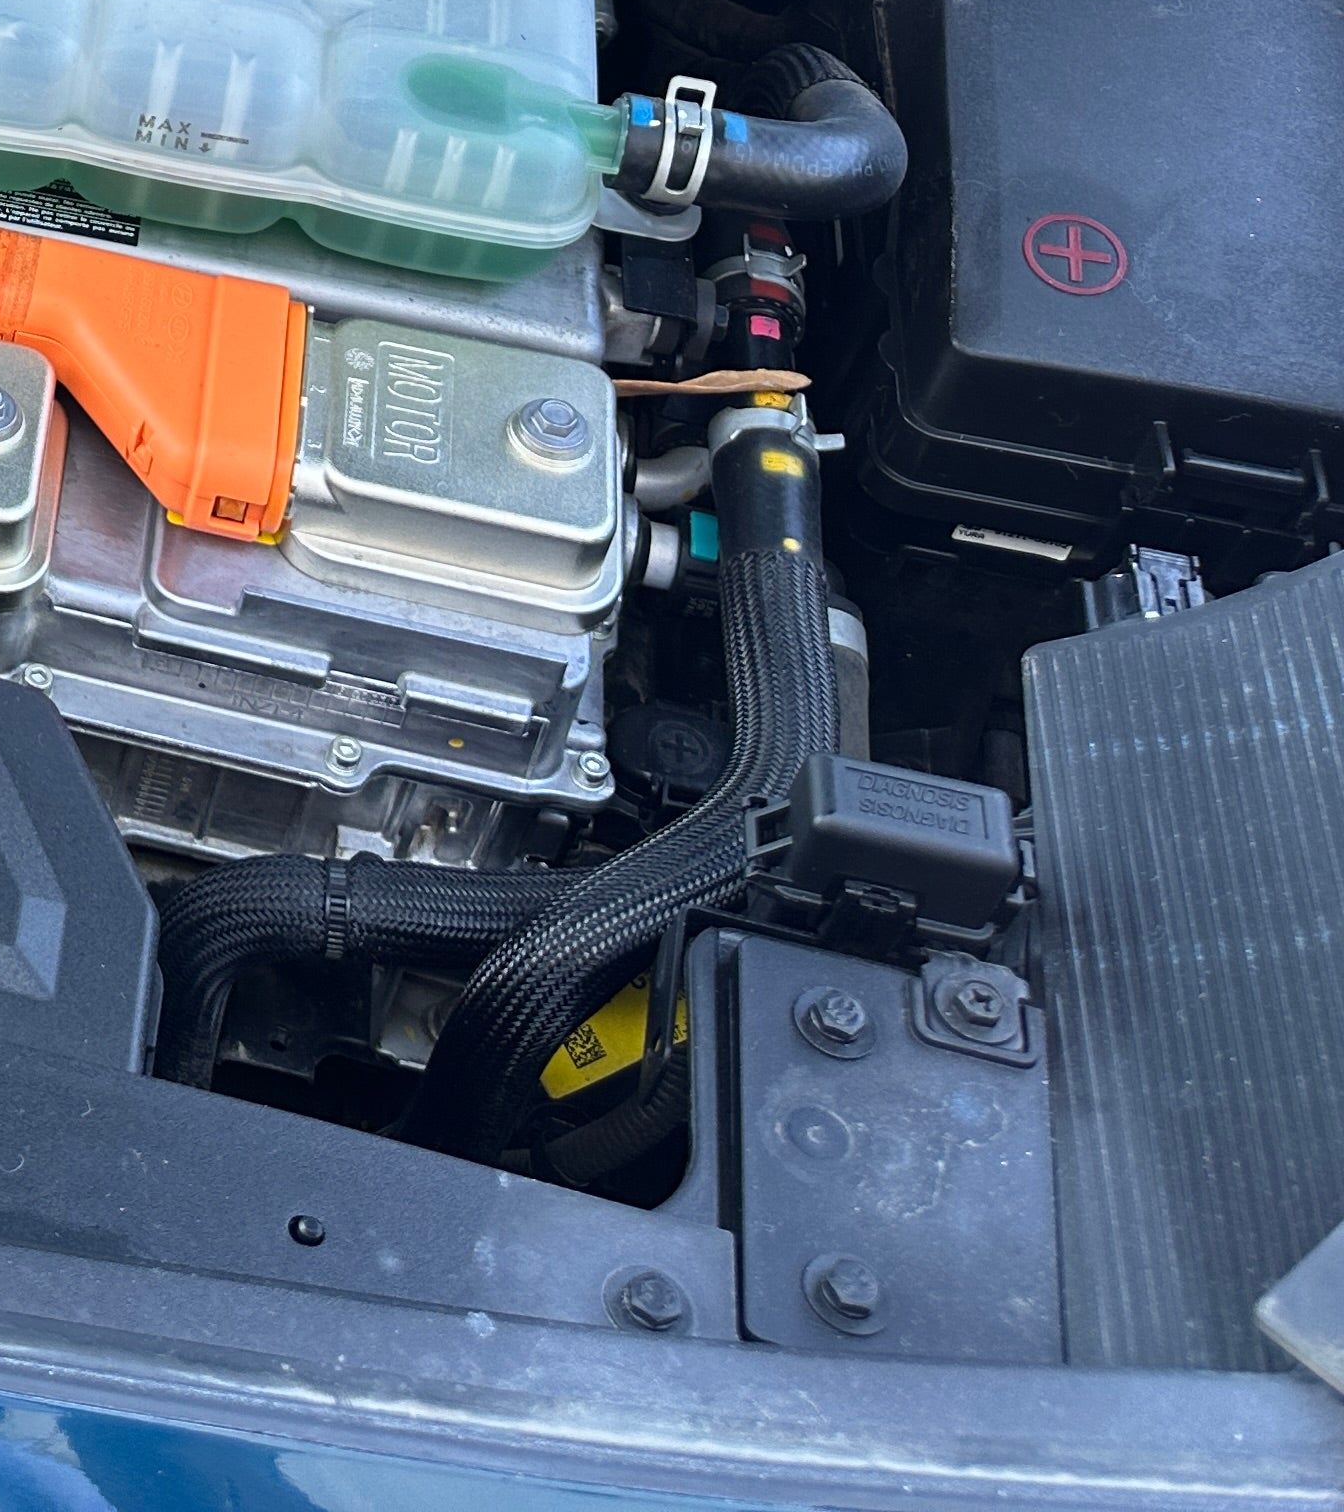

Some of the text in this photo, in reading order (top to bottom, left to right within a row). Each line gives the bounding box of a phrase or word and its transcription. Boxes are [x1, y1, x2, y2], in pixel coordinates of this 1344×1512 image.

[134, 128, 189, 151] MIN
[138, 112, 192, 135] MAX
[383, 353, 444, 464] MOTOR
[857, 772, 970, 812] DIAGNOSIS
[858, 798, 971, 835] DIAGNOSIS
